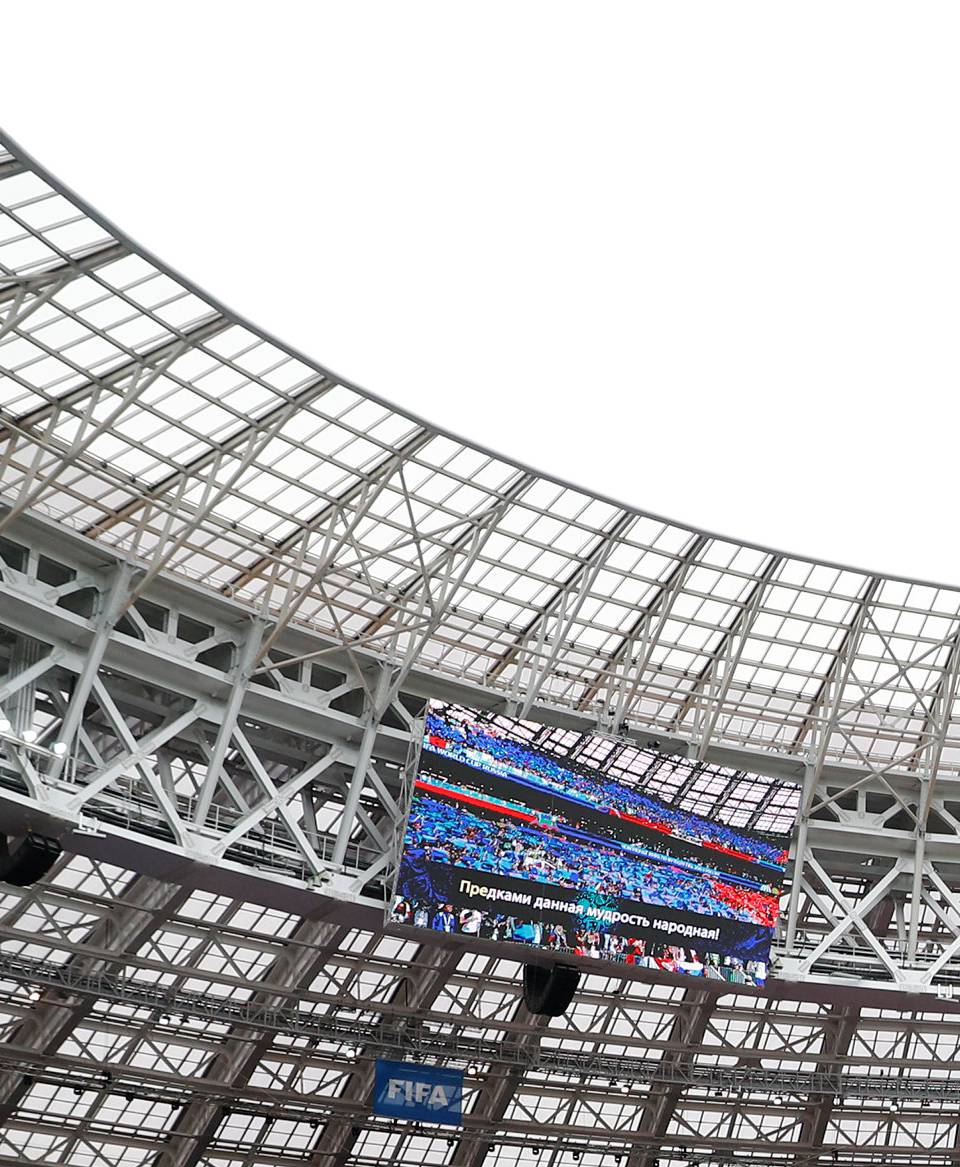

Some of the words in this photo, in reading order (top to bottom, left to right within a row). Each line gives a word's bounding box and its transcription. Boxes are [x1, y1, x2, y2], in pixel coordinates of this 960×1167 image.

[459, 879, 532, 906] Предками
[533, 897, 583, 915] данная
[586, 905, 650, 929] мудрость
[652, 919, 720, 941] народная!
[387, 1079, 449, 1106] FIFA
